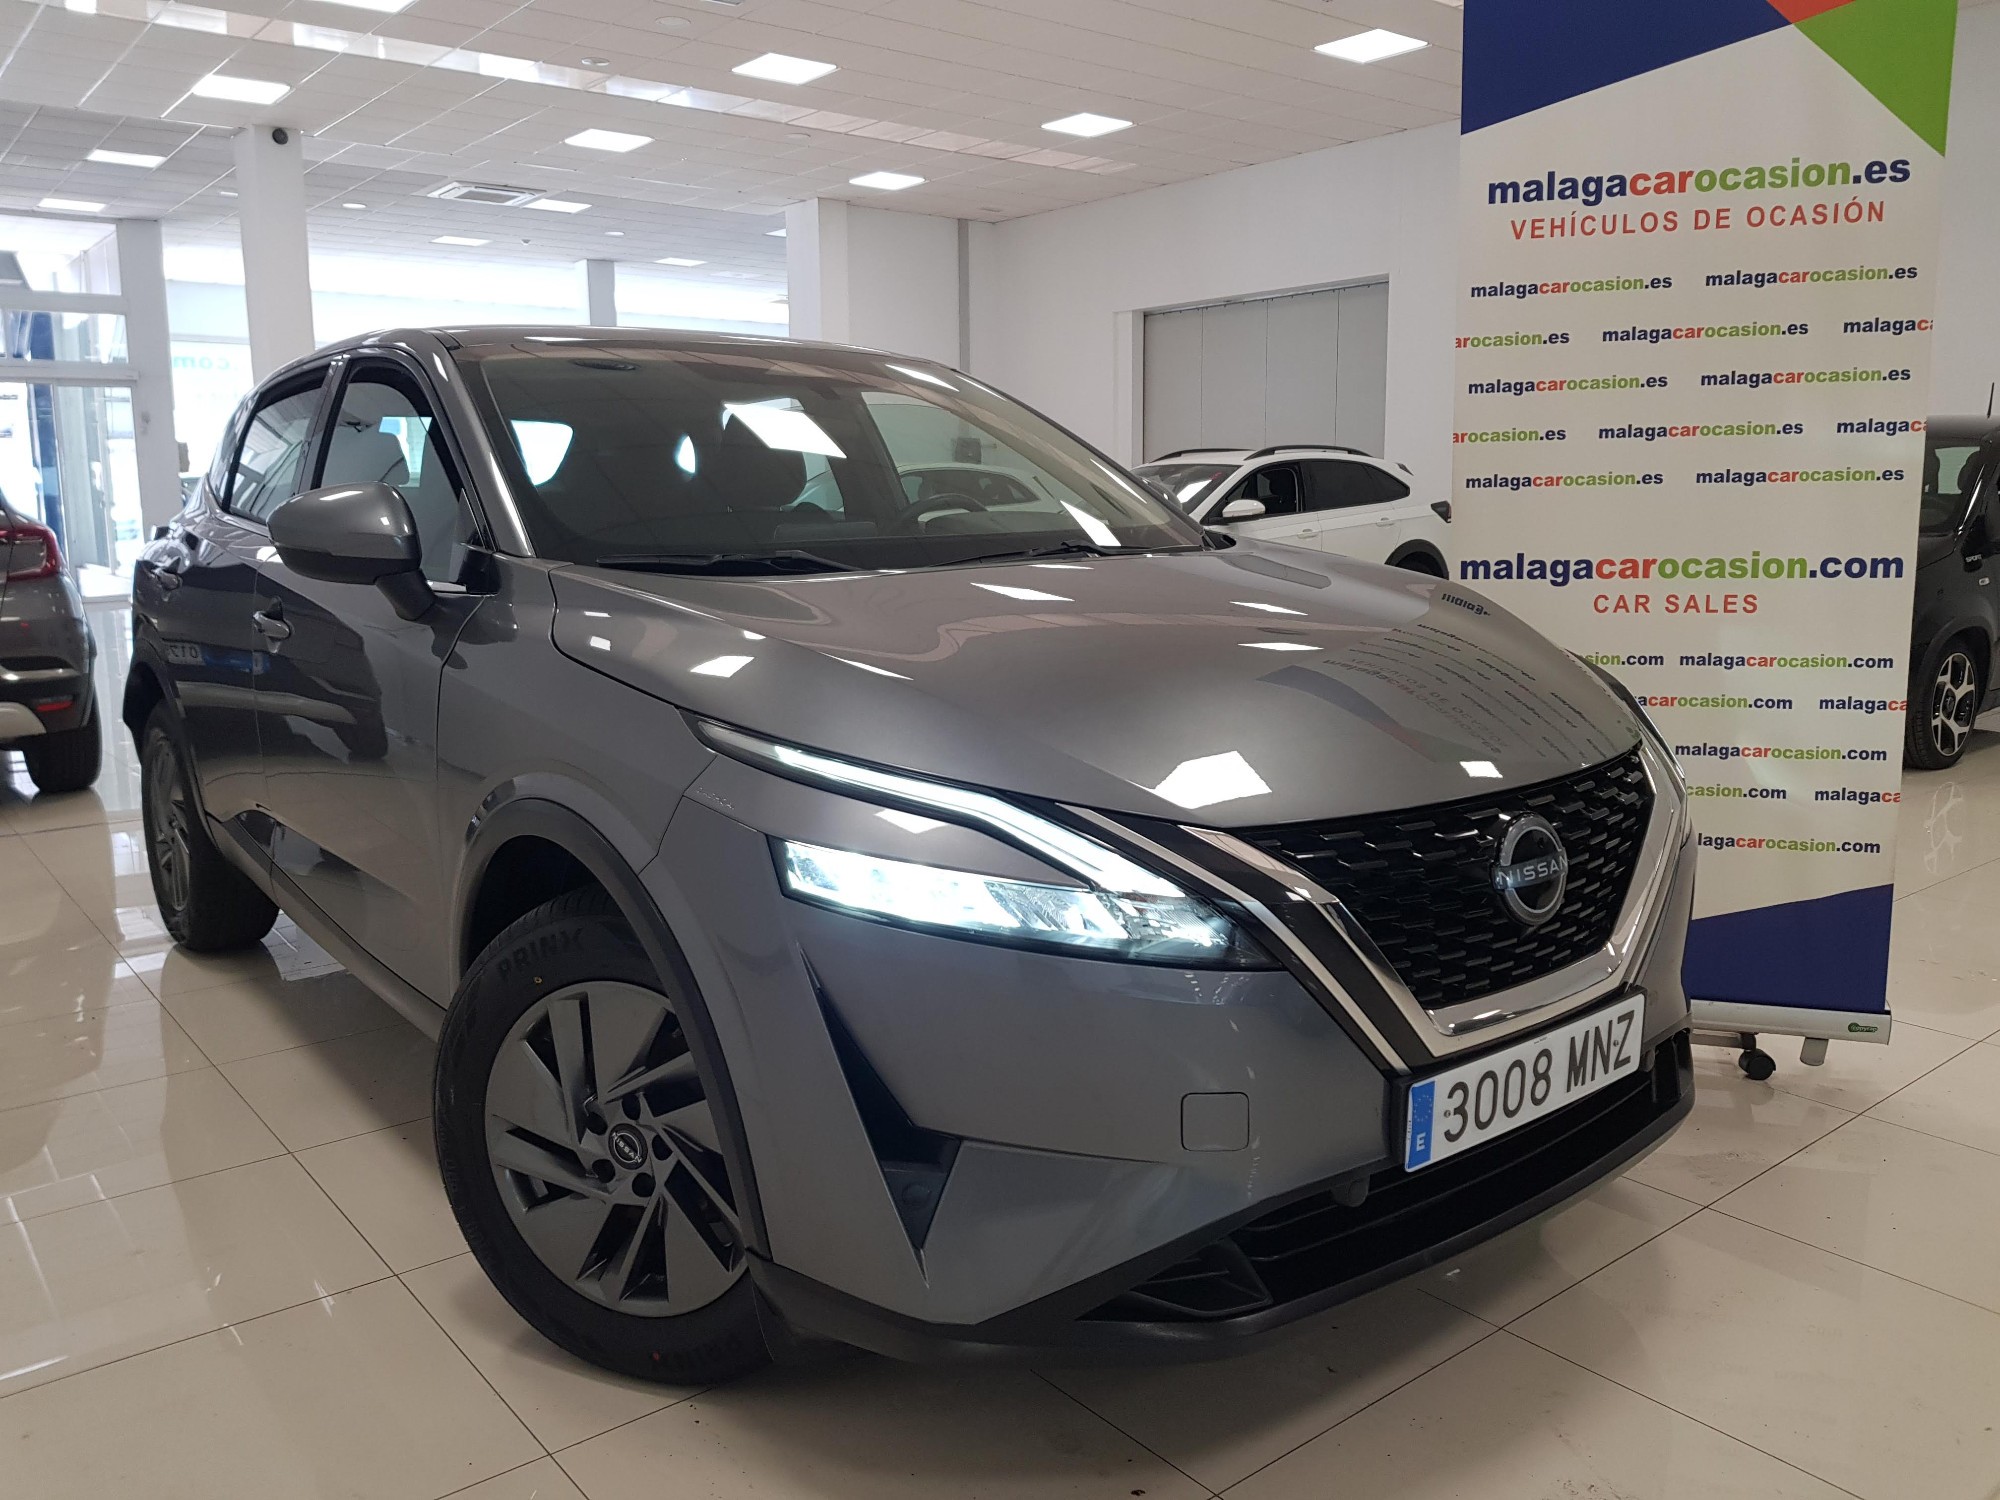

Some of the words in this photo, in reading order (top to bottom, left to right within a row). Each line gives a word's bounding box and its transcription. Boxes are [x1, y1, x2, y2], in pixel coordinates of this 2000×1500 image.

[1488, 157, 1911, 206] malagacarocasion.es
[1510, 210, 1678, 240] VEHÍCULOS
[1694, 208, 1731, 230] DE
[1746, 196, 1884, 228] OCASIÓN
[1471, 275, 1672, 299] malagacarocasion.es
[1705, 265, 1917, 288] malagacarocasion.es
[1602, 321, 1809, 343] malagacarocasion.es
[1843, 317, 1933, 336] malagac
[1468, 374, 1668, 396] malagacarocasion.es
[1700, 366, 1911, 388] malagacarocasion.es
[1598, 420, 1804, 441] malagacarocasion.es
[1465, 471, 1664, 491] malagacarocasion.es
[1695, 466, 1905, 487] malagacarocasion.es
[1460, 551, 1904, 587] malagacarocasion.com
[1593, 594, 1651, 614] CAR
[1665, 594, 1758, 614] SALES
[1580, 652, 1664, 666] sion.com
[1679, 652, 1894, 670] malagacarocasion.com
[1635, 694, 1793, 709] acarocasion.com
[1675, 743, 1887, 761] malagacarocasion.com
[1497, 856, 1568, 886] NISSAN
[496, 926, 585, 982] PRINX
[1444, 1048, 1553, 1143] 3008
[1566, 1010, 1635, 1093] MNZ
[612, 1132, 642, 1163] NISSAN
[1416, 1132, 1427, 1152] E
